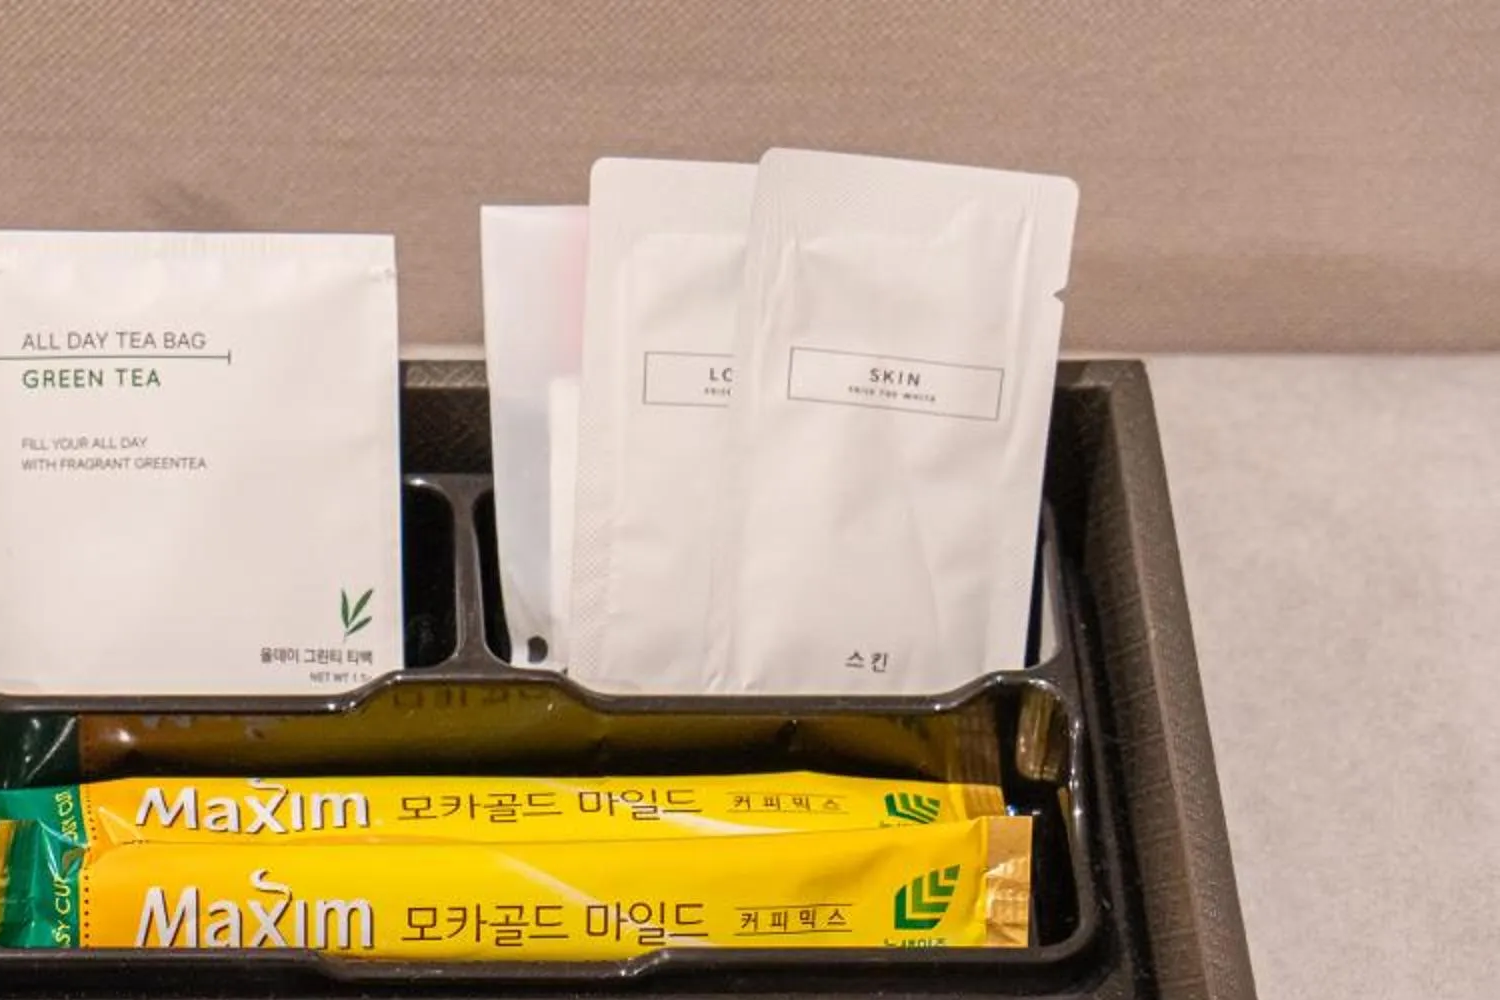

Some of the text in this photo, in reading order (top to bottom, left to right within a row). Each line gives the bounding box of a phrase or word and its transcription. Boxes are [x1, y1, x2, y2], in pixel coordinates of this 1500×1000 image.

[21, 331, 207, 350] ALL DAY TEA BAG
[22, 368, 162, 388] GREEN TEA
[869, 367, 922, 387] SKIN
[21, 436, 148, 450] FILL YOUR ALL DAY
[21, 457, 208, 470] WITH FRAGRANT GREENTEA
[844, 650, 888, 673] 스킨
[135, 778, 370, 834] Maxim
[397, 791, 564, 823] 모카골드
[578, 788, 704, 821] 마일드
[134, 869, 374, 949] Maxim
[401, 901, 847, 948] 모카골드 마일드 커피믹스
